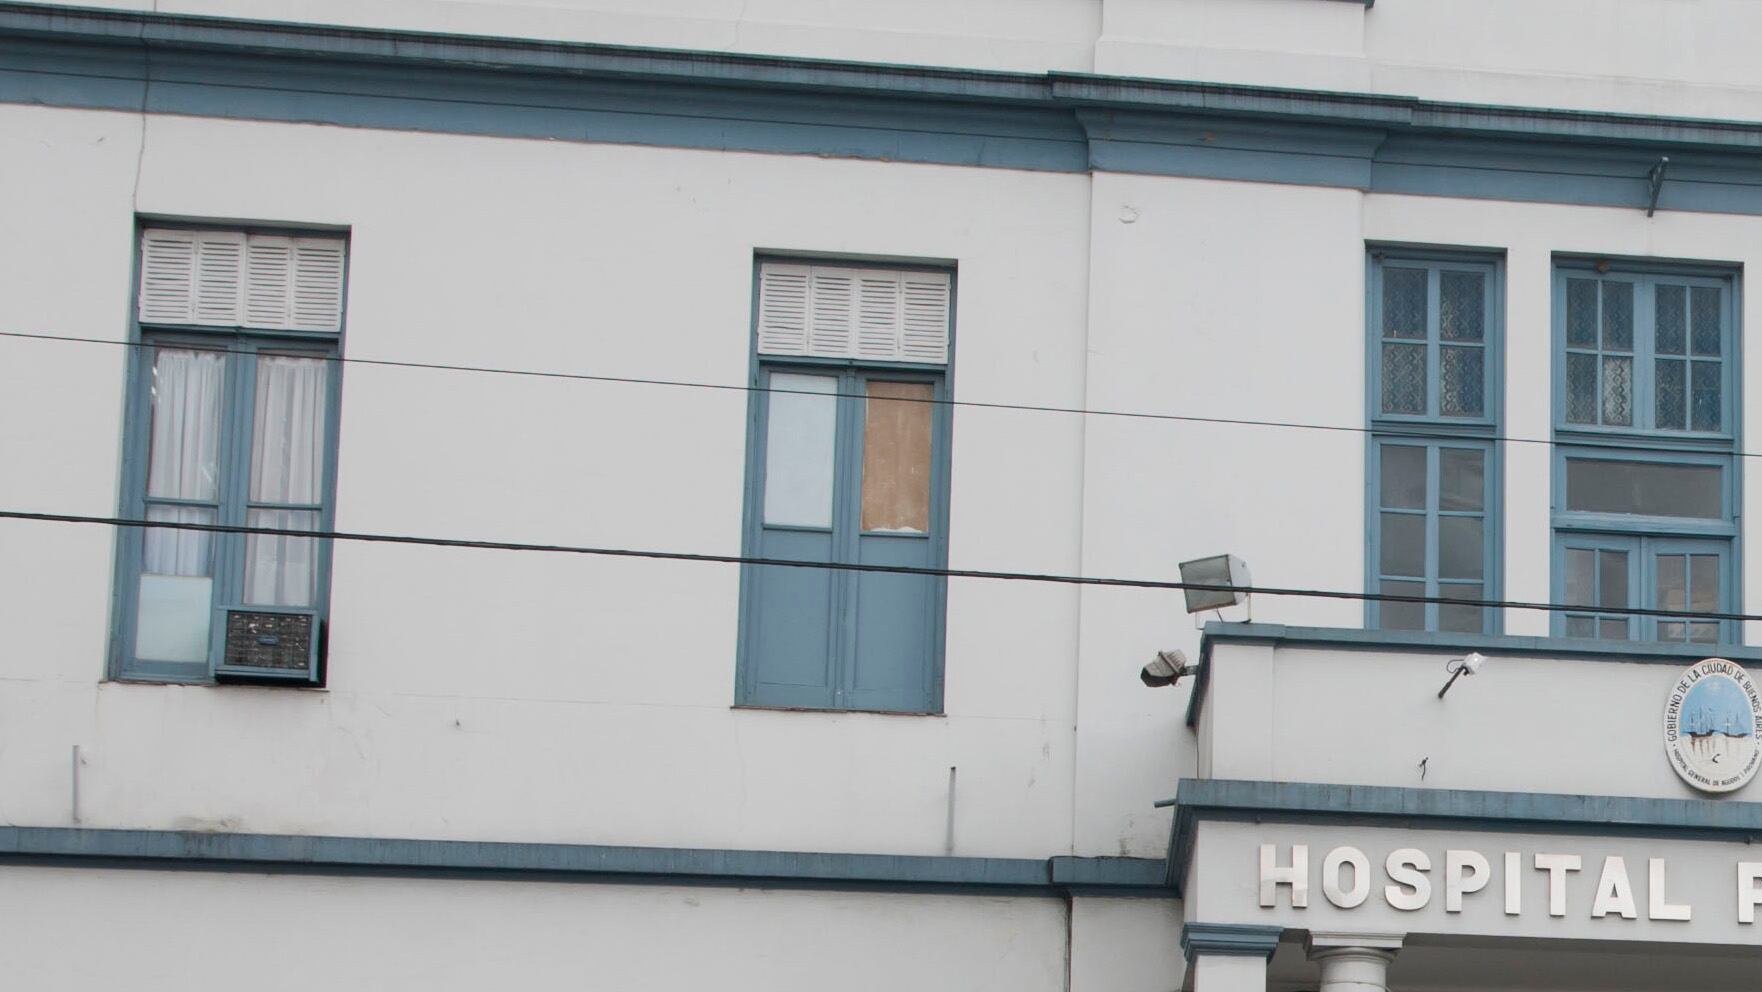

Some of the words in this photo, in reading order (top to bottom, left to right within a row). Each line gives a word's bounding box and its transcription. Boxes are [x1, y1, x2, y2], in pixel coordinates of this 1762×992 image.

[1667, 693, 1683, 741] GOBIERNO
[1677, 680, 1690, 693] DE
[1688, 669, 1701, 683] LA
[1702, 662, 1734, 675] CIUDAD
[1734, 670, 1744, 683] DE
[1743, 680, 1761, 713] BUENOS
[1688, 767, 1711, 785] GENERAL
[1259, 843, 1692, 921] HOSPITAL
